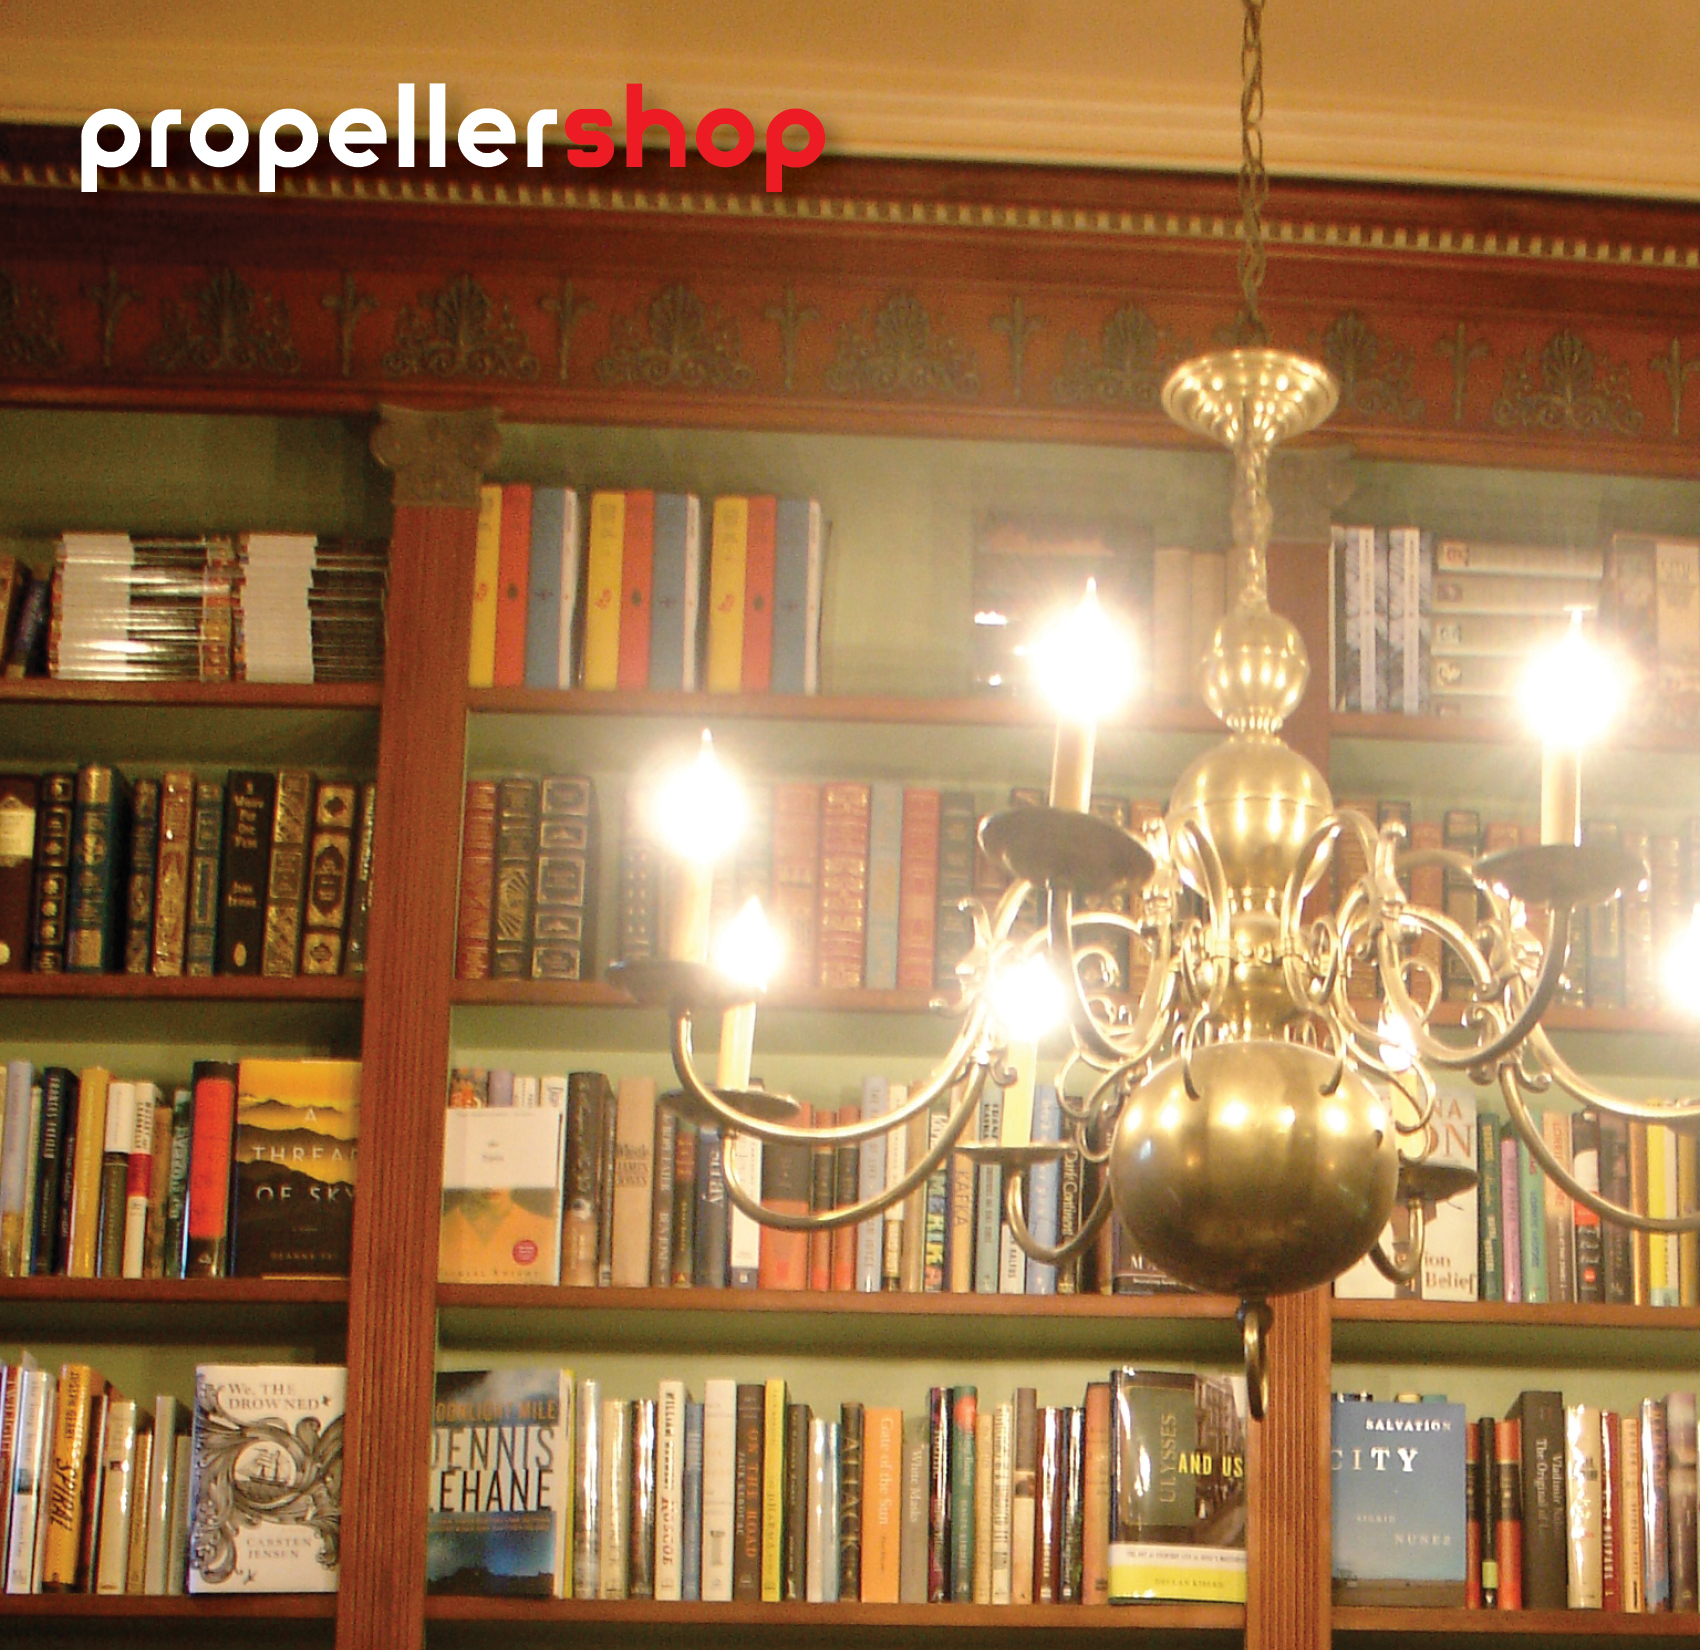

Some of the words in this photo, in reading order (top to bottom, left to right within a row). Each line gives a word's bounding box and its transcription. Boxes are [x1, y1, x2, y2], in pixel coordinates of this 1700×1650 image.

[305, 1108, 317, 1122] A
[1062, 1151, 1077, 1181] Dark
[255, 1187, 292, 1200] OF
[309, 1186, 356, 1201] SKY
[954, 1170, 970, 1226] KAFKA
[1061, 1183, 1077, 1235] Continent
[227, 1397, 319, 1410] DROWNED
[878, 1416, 894, 1443] Gate
[1364, 1418, 1453, 1432] SALVATION
[430, 1428, 555, 1471] DENNIS
[878, 1447, 894, 1462] of
[1160, 1412, 1176, 1504] ULYSSES
[1536, 1438, 1547, 1460] The
[909, 1449, 923, 1482] White
[1177, 1452, 1214, 1475] AND
[1221, 1452, 1243, 1476] US
[841, 1435, 860, 1549] ATTACK
[878, 1466, 893, 1493] the
[49, 1457, 78, 1532] SPIRAL
[909, 1485, 922, 1522] Masks
[878, 1497, 892, 1525] Sun
[247, 1548, 300, 1559] JENSEN
